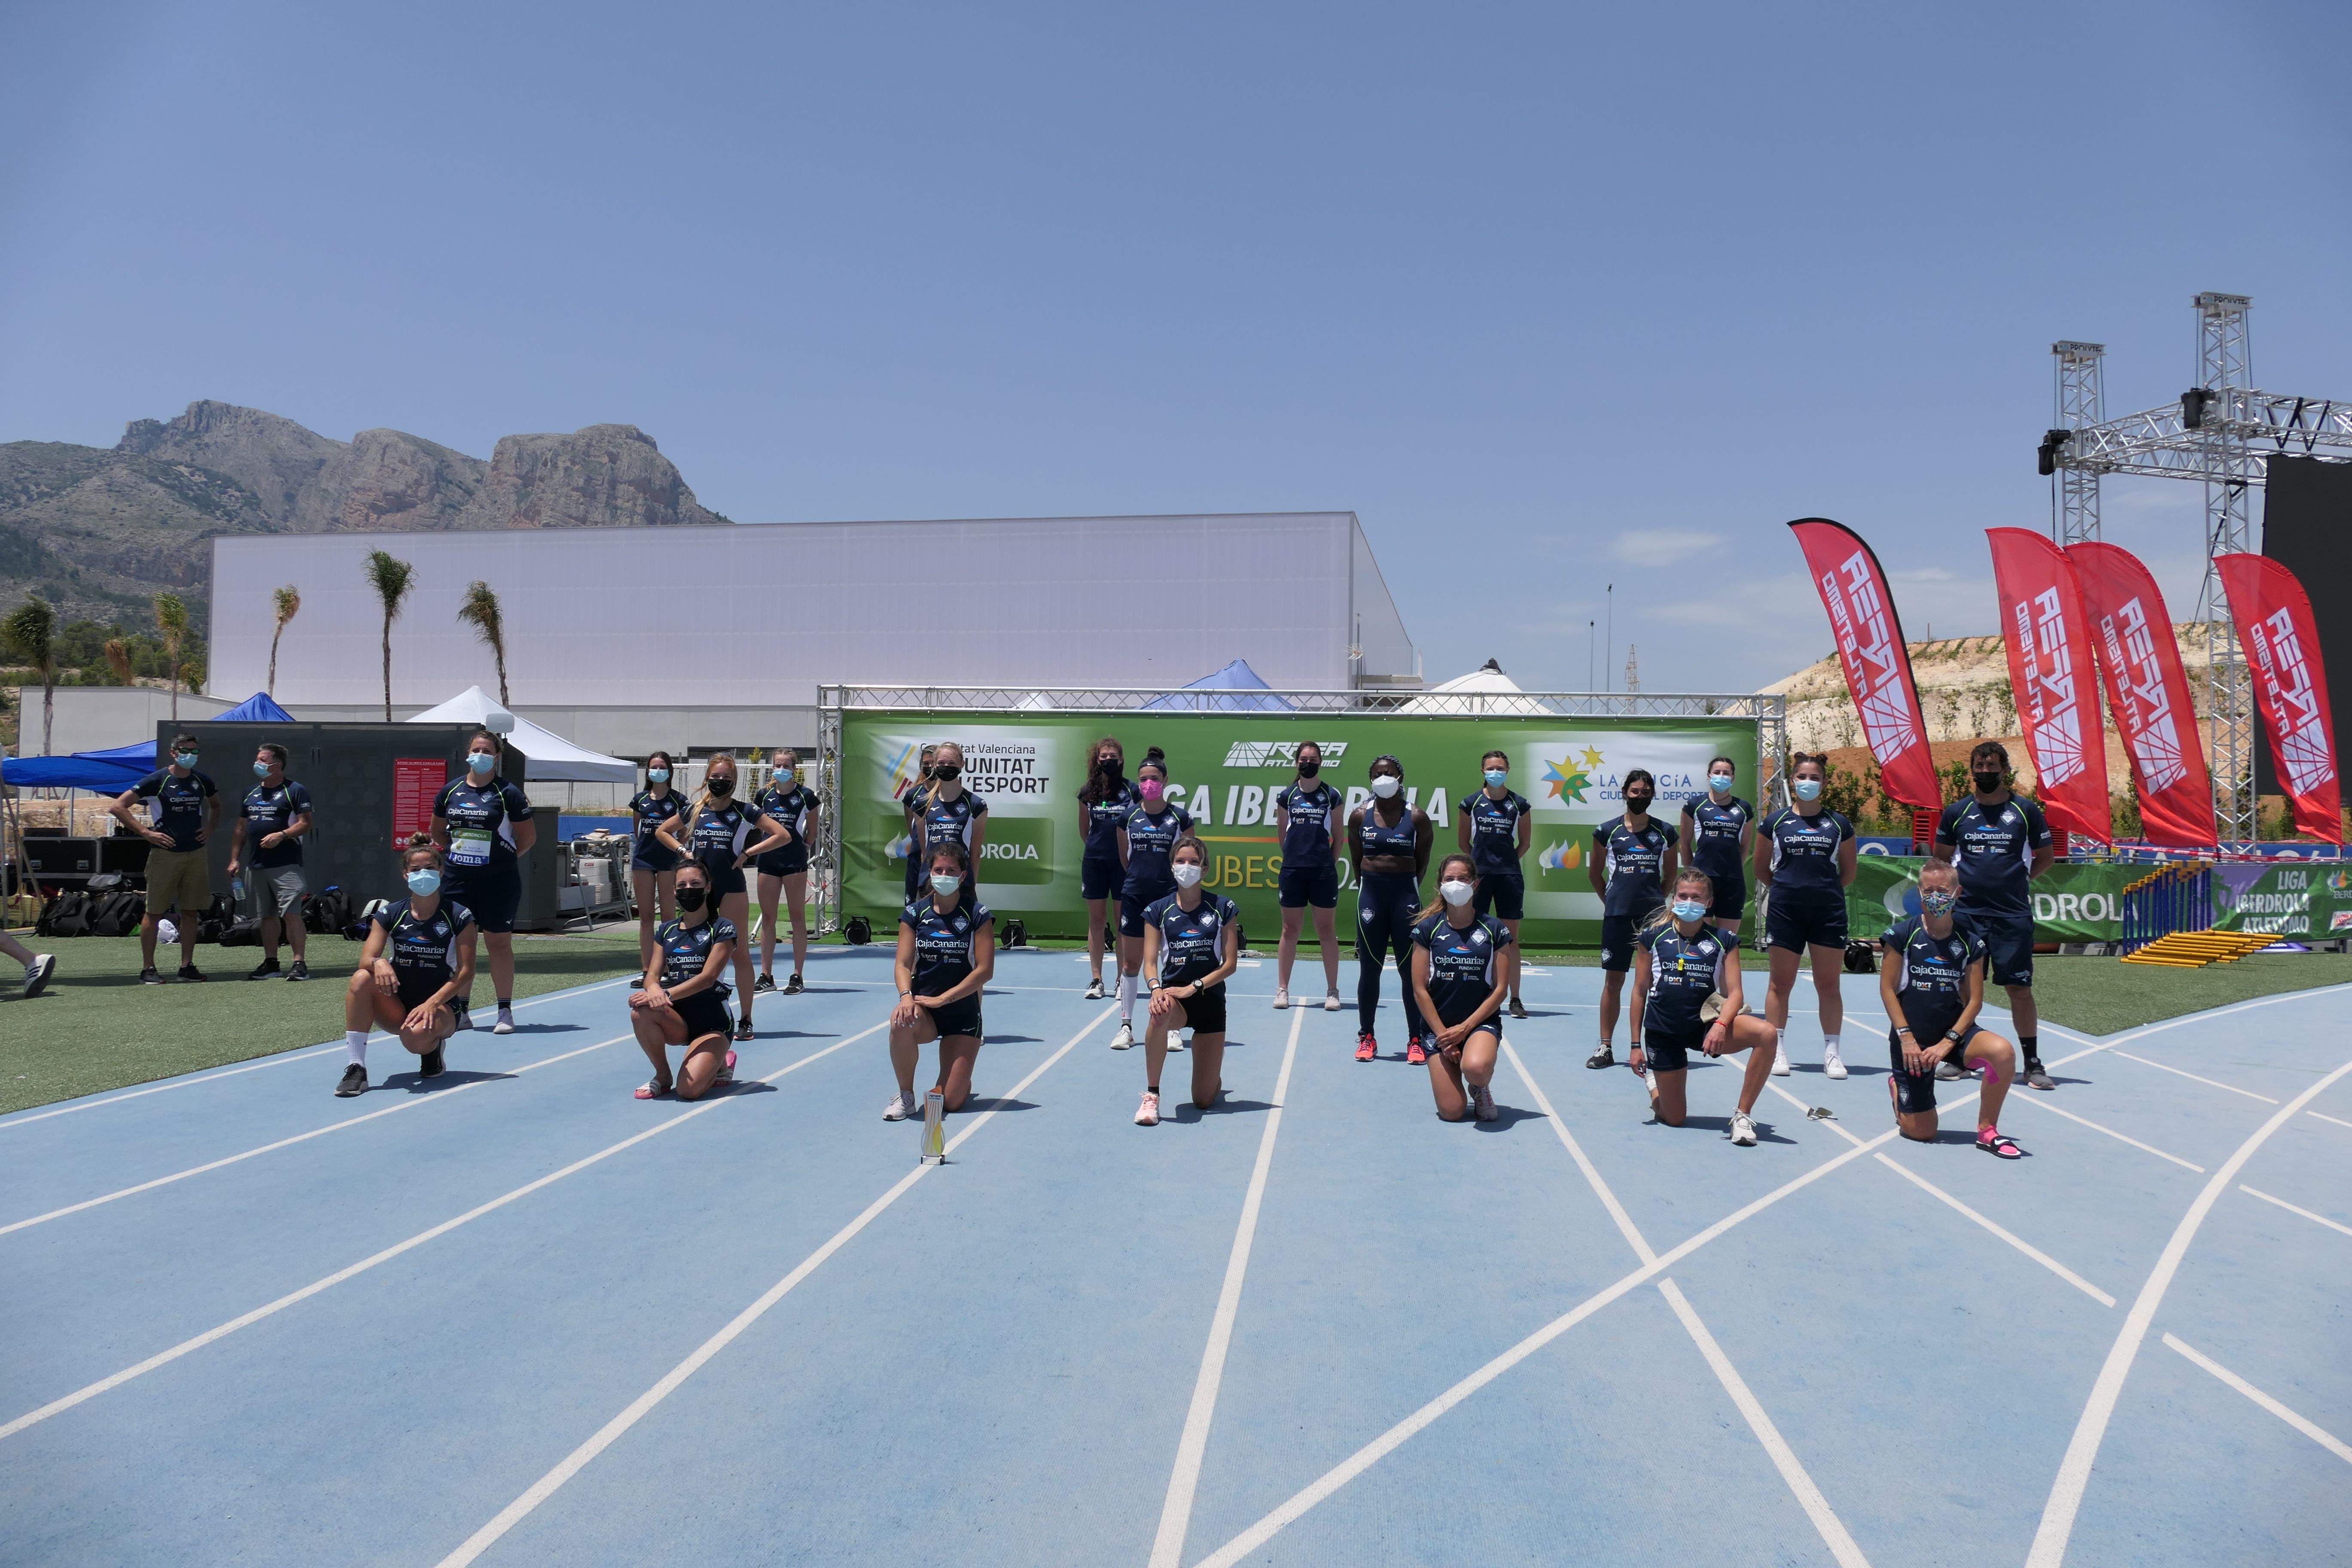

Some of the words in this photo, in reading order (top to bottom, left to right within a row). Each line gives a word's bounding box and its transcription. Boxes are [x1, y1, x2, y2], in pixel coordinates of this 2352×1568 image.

[978, 744, 1036, 754] Valenciana
[960, 757, 1035, 775] UNITAT
[1600, 774, 1618, 787] LA
[1599, 791, 1623, 800] CIUD
[1163, 784, 1211, 825] GA
[448, 808, 489, 816] CajaCanarias
[1477, 816, 1513, 825] CajaCanarias
[1703, 820, 1740, 830] CajaCanarias
[928, 822, 963, 831] CajaCanarias
[694, 829, 734, 837] CajaCanarias
[1131, 832, 1173, 840] CajaCanarias
[1964, 832, 2012, 841] CajaCanarias
[1784, 835, 1832, 844] CajaCanarias
[1617, 853, 1659, 862] CajaCanarias
[1200, 855, 1283, 888] UBES
[2278, 871, 2307, 890] LIGA
[2235, 893, 2309, 913] IBERDROLA
[917, 939, 968, 949] CajaCanarias
[1169, 937, 1213, 950] CajaCanarias
[395, 943, 445, 955] CajaCanarias
[1435, 956, 1485, 966] CajaCanarias
[1909, 965, 1960, 978] CajaCanarias
